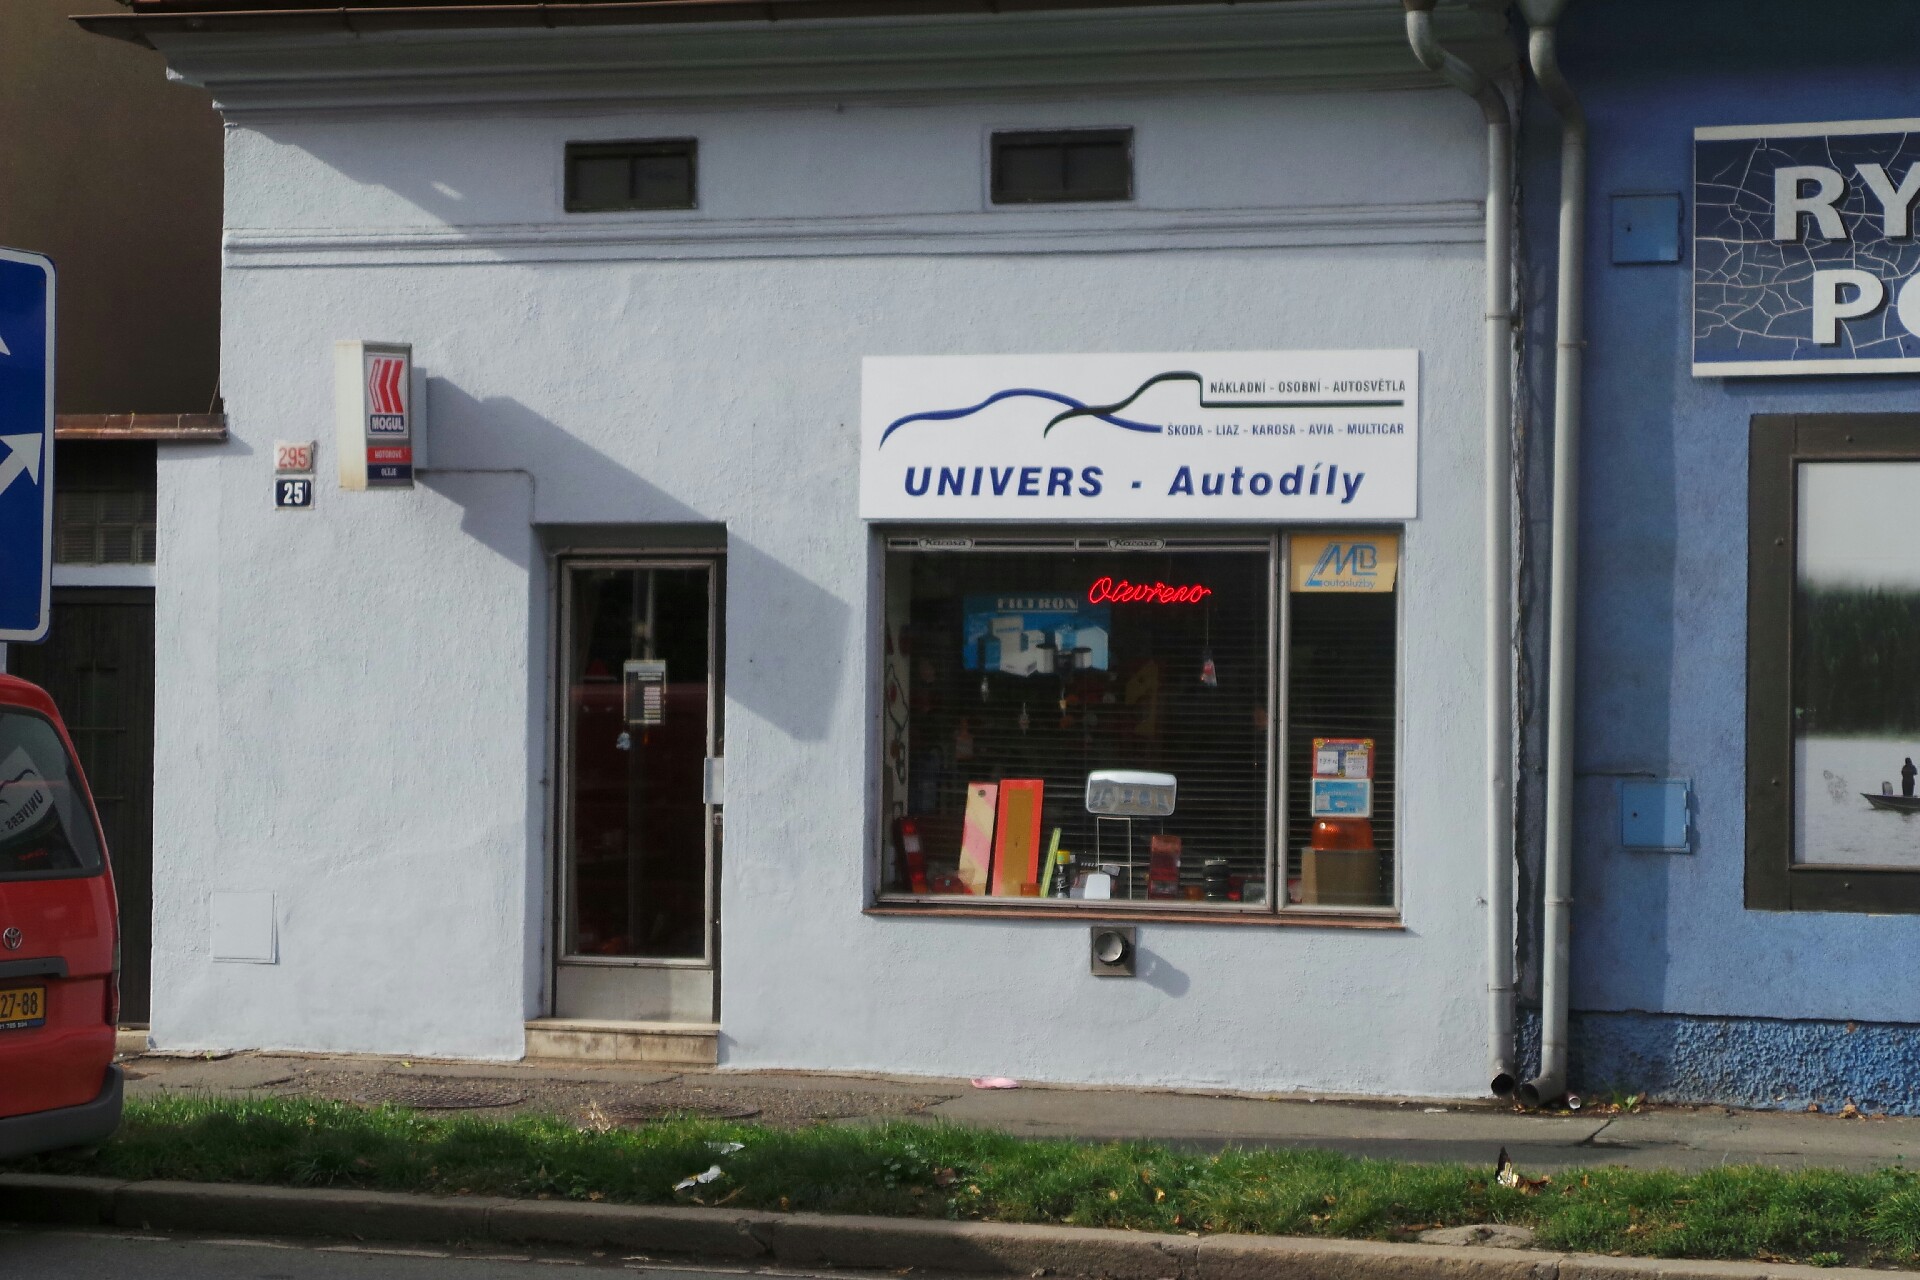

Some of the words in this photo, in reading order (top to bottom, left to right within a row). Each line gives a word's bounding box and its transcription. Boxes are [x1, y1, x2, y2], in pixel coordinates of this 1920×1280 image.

[1210, 378, 1266, 394] NÁKLADNÍ
[1278, 377, 1321, 393] OSOBNÍ
[1332, 377, 1406, 393] AUTOSVĚTLA
[371, 416, 404, 431] MOGUL
[1166, 422, 1204, 436] ŠKODA
[1215, 424, 1240, 436] LIAZ
[1252, 424, 1296, 436] KAROSA
[1308, 423, 1334, 435] AVIA
[1347, 423, 1404, 435] MULTICAR
[278, 446, 308, 469] 295
[904, 465, 1104, 497] UNIVERS
[1167, 462, 1365, 505] Autodíly
[1088, 575, 1213, 605] Otevřeno
[1323, 578, 1376, 590] autoslužby
[996, 597, 1079, 610] FILTRON
